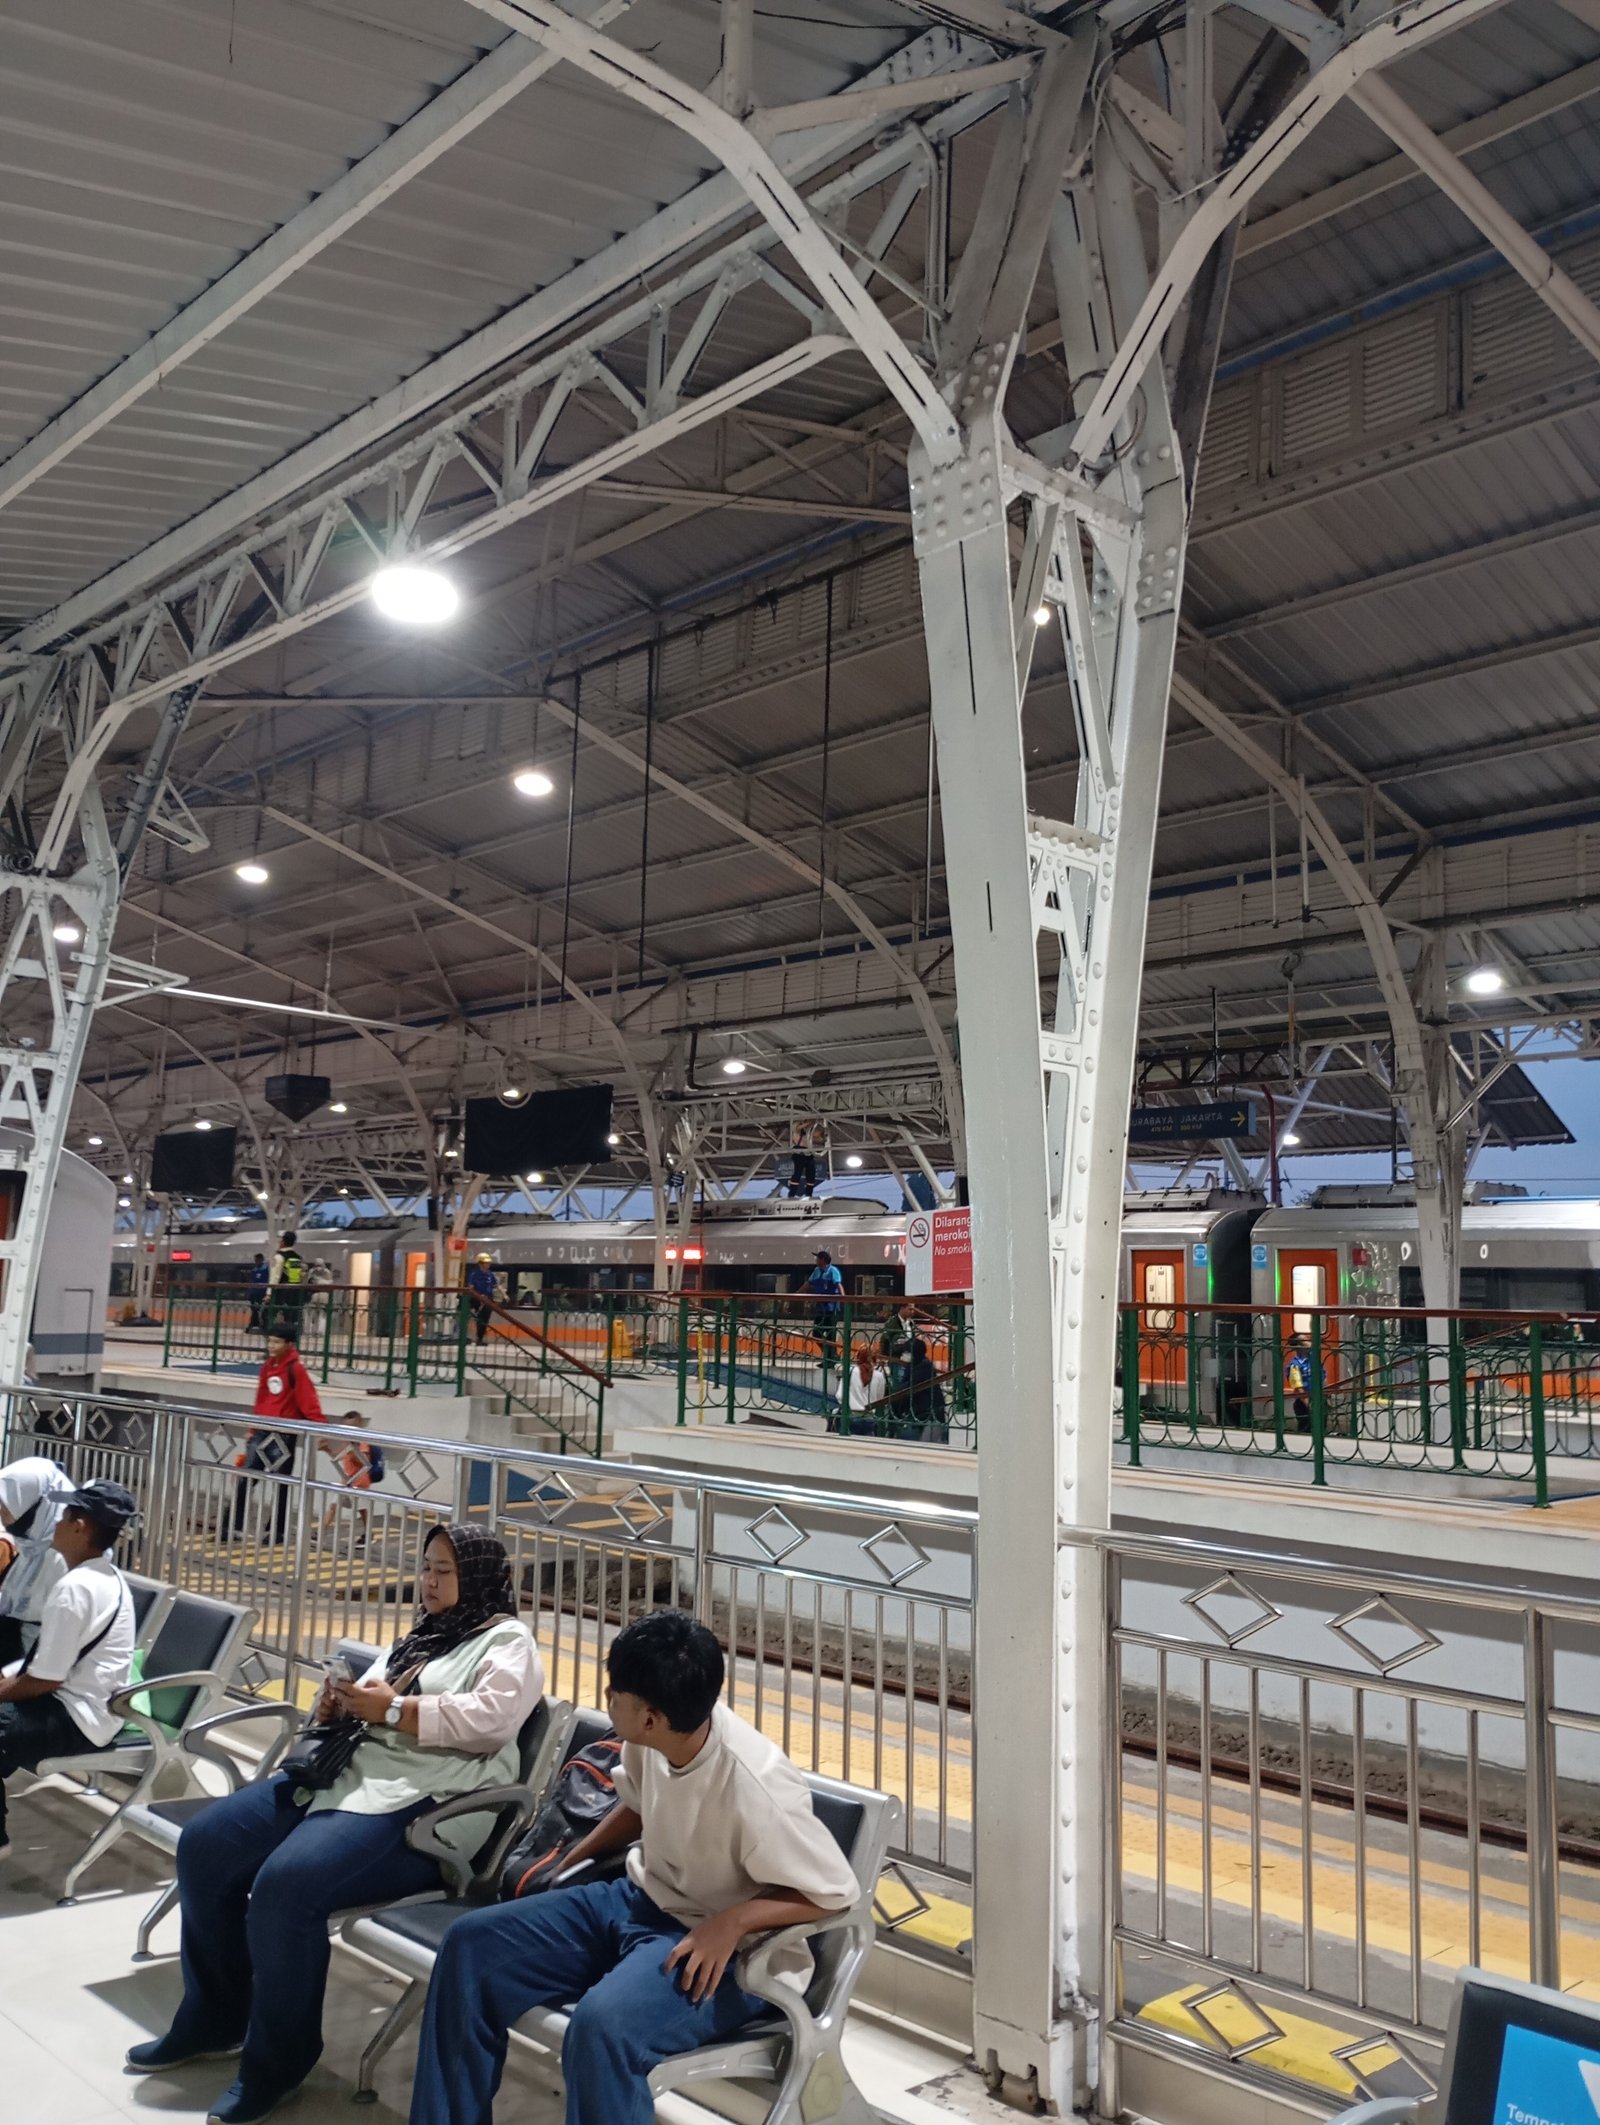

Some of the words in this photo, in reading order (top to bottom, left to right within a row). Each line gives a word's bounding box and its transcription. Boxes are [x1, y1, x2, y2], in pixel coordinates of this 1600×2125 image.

[1131, 1115, 1174, 1127] URABAYA
[1180, 1112, 1223, 1123] JAKARTA
[935, 1216, 971, 1228] Dilarang
[935, 1228, 970, 1242] meroko
[934, 1245, 946, 1256] No
[947, 1242, 971, 1255] smoki
